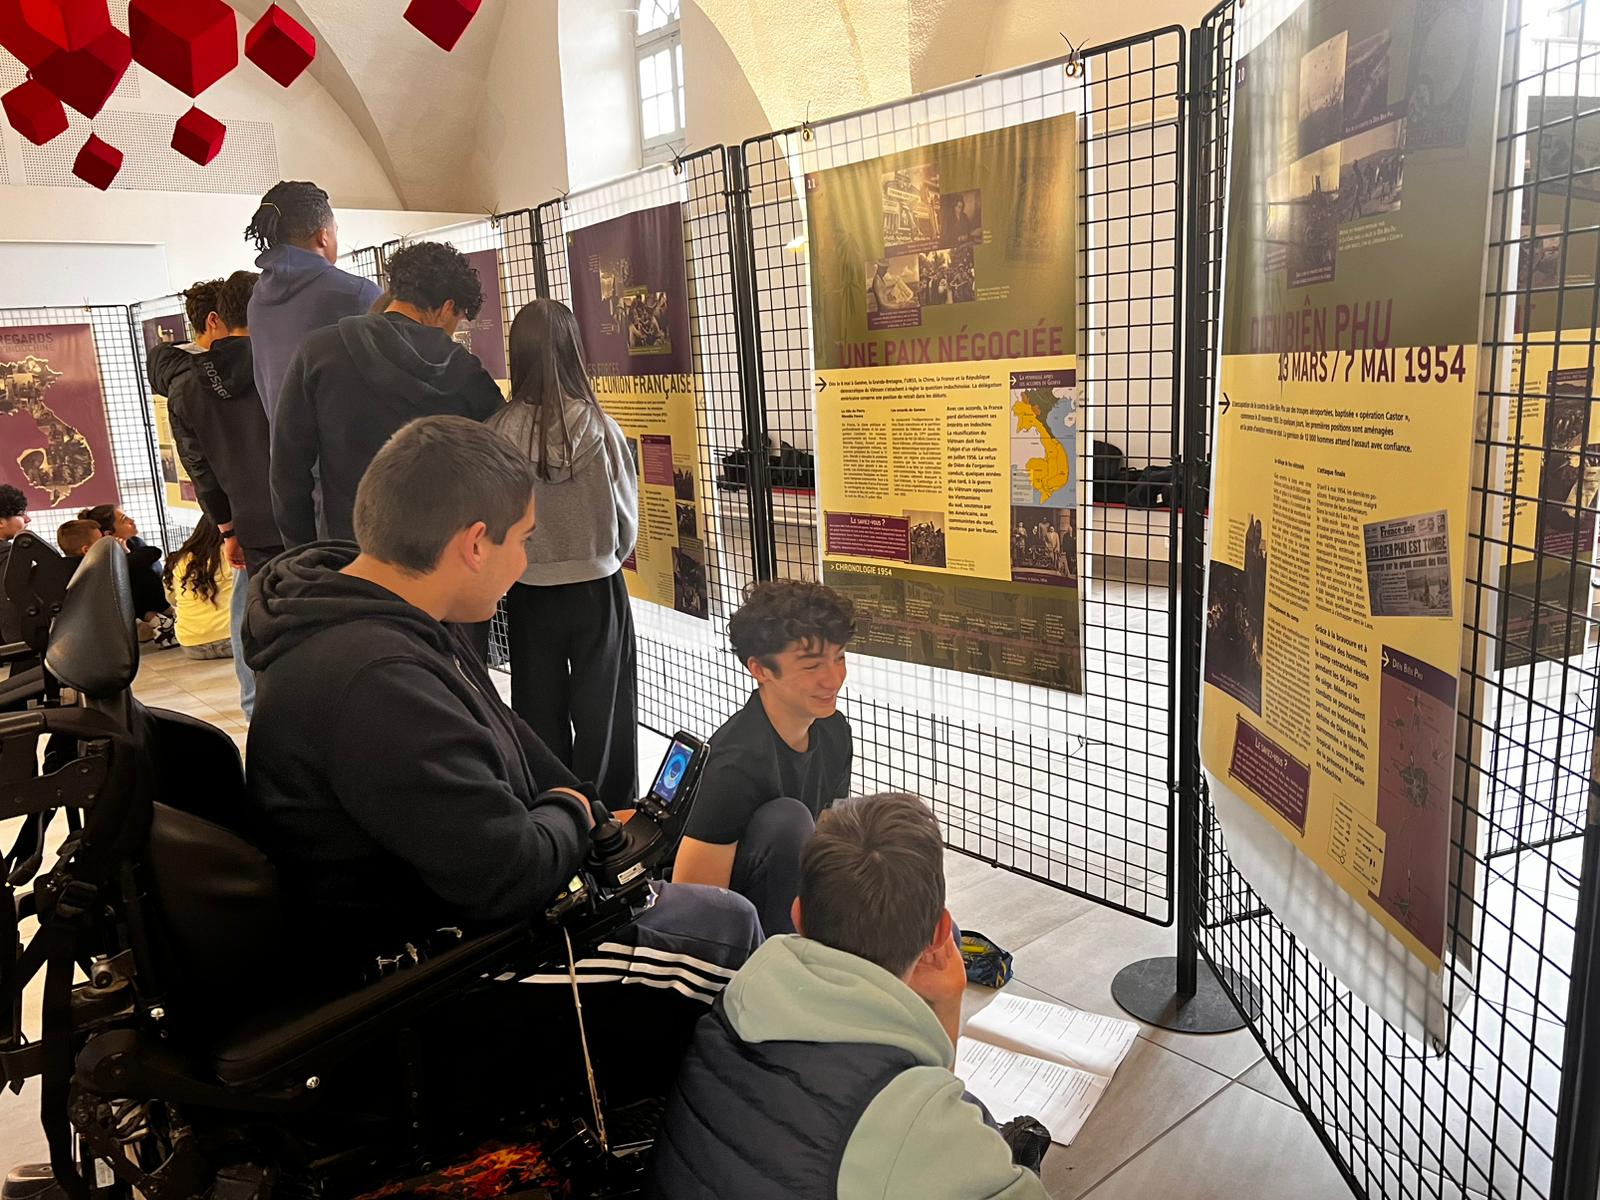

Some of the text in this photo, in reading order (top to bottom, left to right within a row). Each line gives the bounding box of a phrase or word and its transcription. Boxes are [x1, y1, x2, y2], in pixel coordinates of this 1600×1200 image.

[808, 178, 816, 188] 11
[1286, 294, 1326, 353] BIÊN
[1335, 298, 1392, 350] PHU
[838, 341, 878, 368] UNE
[884, 337, 932, 366] PAIX
[939, 318, 1064, 364] NÉGOCIÉE
[1278, 343, 1466, 384] 13 MARS / 7 MAI 1954
[634, 374, 692, 400] FRANÇAISE
[1335, 409, 1354, 419] baptisée
[1359, 410, 1384, 420] opération
[1386, 411, 1403, 421] Castor
[1331, 423, 1351, 432] positions
[1364, 426, 1394, 437] aménagées
[1317, 434, 1334, 444] hommes
[1335, 437, 1350, 446] attend
[1352, 438, 1370, 448] l'assaut
[1384, 442, 1412, 453] confiance.
[1408, 539, 1422, 554] EST
[836, 563, 892, 576] CHRONOLOGIE 1954
